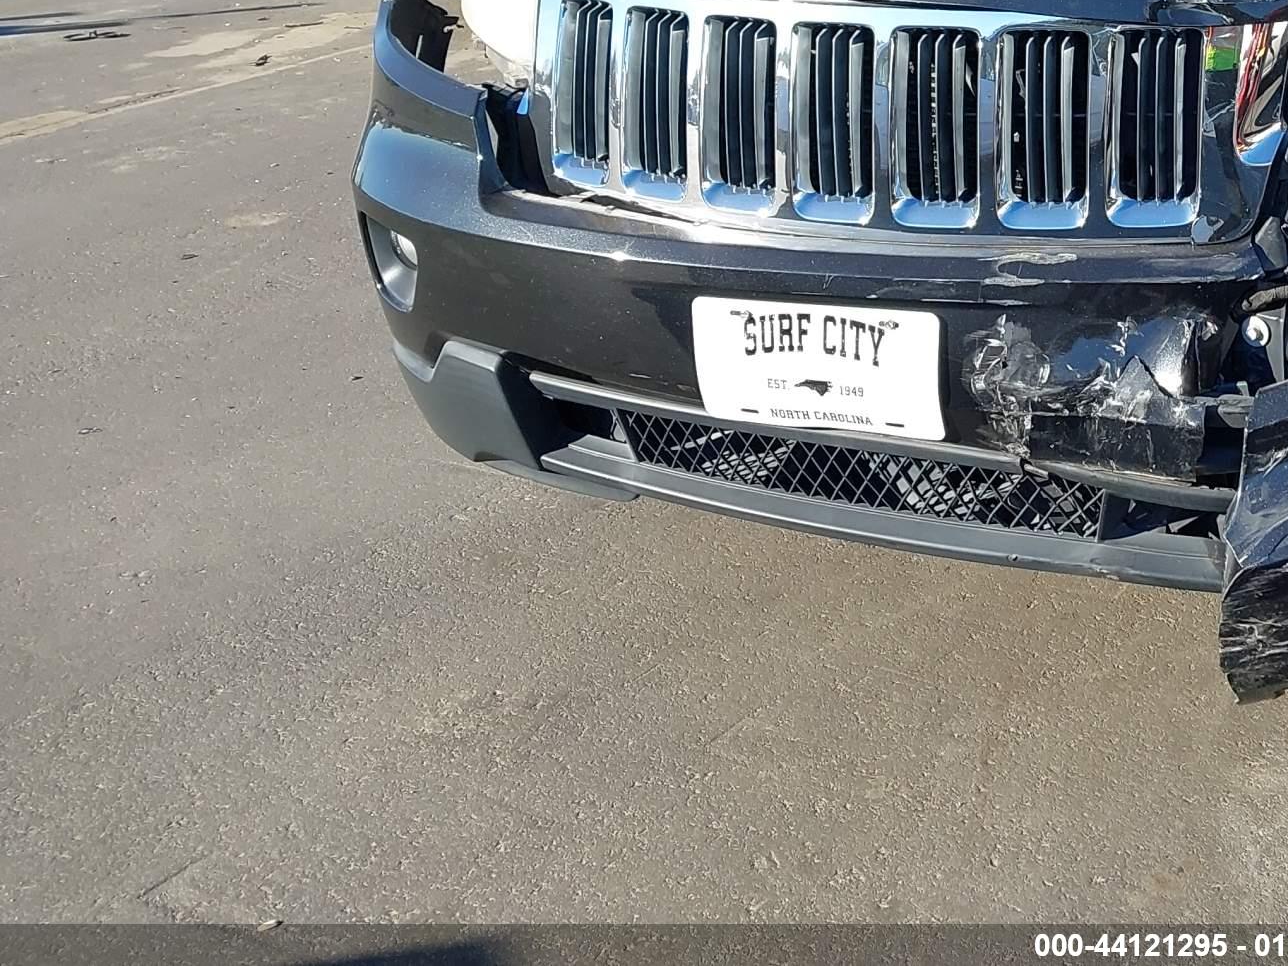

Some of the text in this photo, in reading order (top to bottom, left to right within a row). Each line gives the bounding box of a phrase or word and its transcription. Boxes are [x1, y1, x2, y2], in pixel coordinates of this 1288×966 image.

[744, 313, 885, 367] SURF CITY
[839, 385, 865, 398] 1949
[770, 408, 873, 426] NORTH CAROLINA
